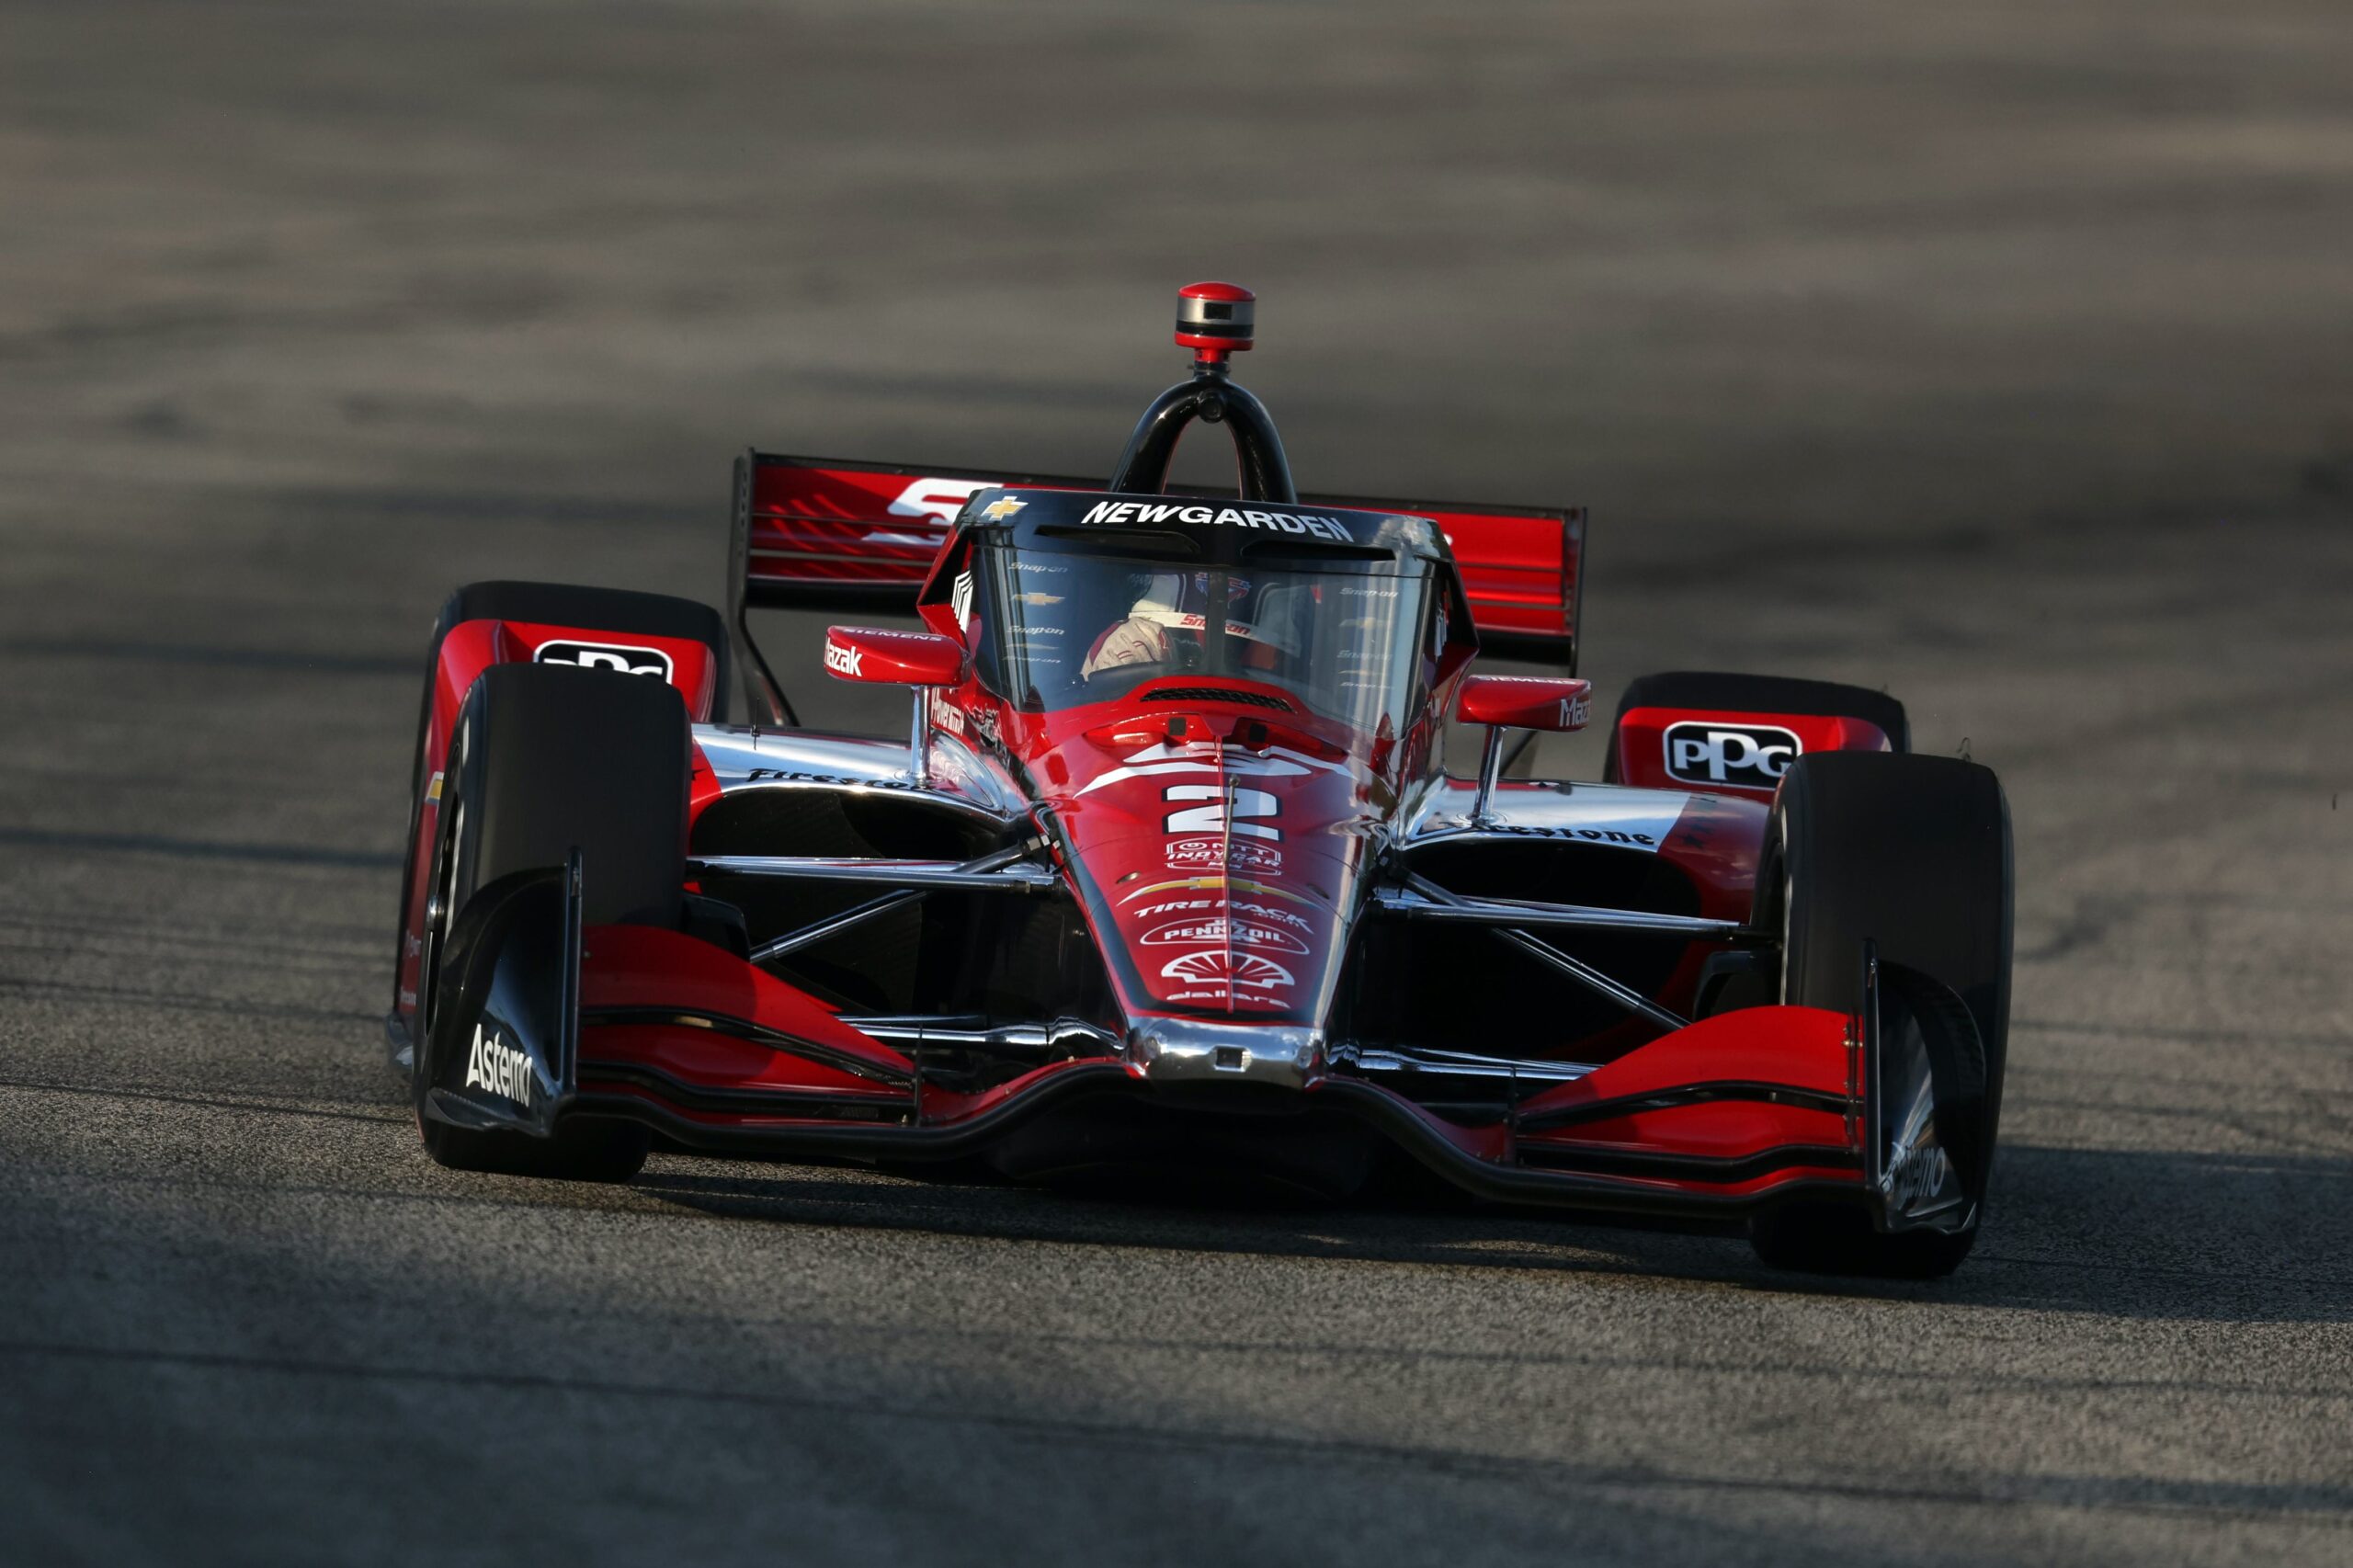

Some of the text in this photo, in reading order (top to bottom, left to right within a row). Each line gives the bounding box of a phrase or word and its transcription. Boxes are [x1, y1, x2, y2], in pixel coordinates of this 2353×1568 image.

[1081, 501, 1354, 543] NEWGARDEN
[1008, 562, 1068, 573] Snap-on
[1006, 625, 1065, 635] Snap-on
[1180, 613, 1251, 635] Sn-on
[844, 628, 942, 642] SIEMENS
[1673, 731, 1792, 780] PPG
[1164, 785, 1281, 841] 2
[1167, 850, 1280, 867] INDYCAR
[1211, 843, 1268, 856] NTT
[1134, 900, 1314, 935] TIRE RACK
[1165, 926, 1286, 942] PENNZOIL
[1166, 990, 1290, 1009] dallara
[465, 1023, 533, 1108] Astemo
